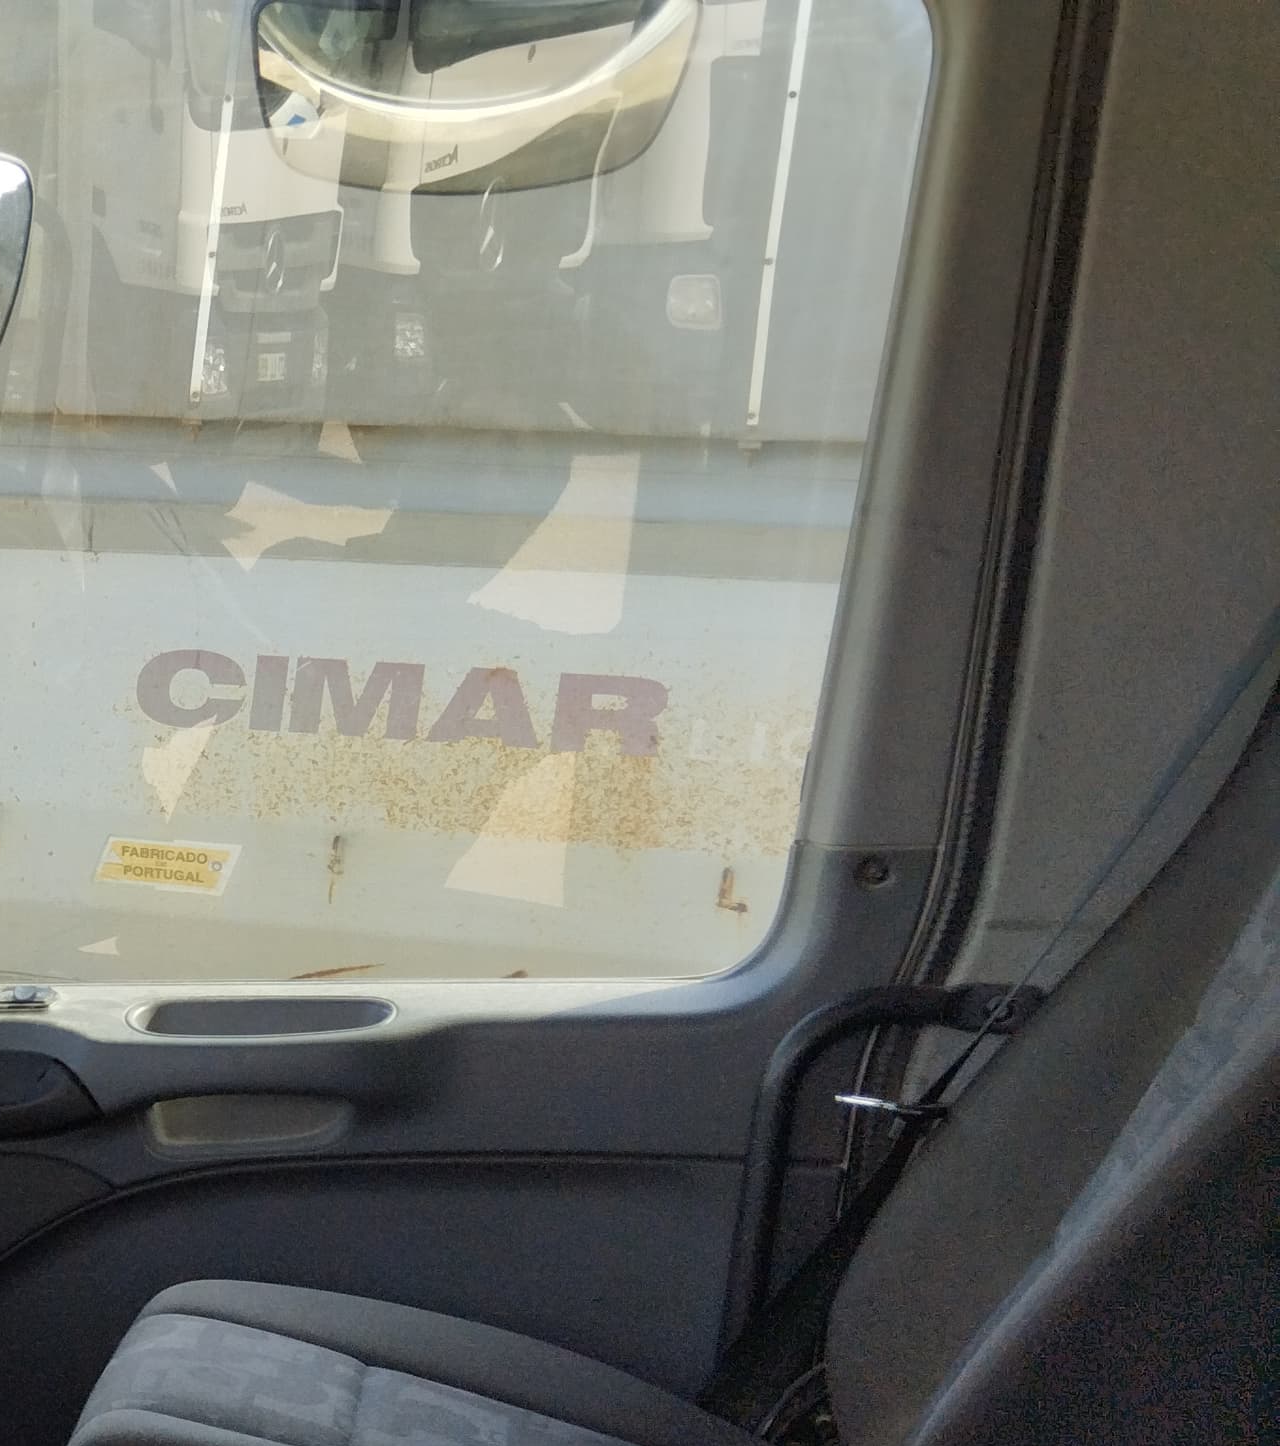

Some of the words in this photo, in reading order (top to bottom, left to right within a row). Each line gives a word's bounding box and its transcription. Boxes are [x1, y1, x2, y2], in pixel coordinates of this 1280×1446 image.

[136, 648, 671, 757] CIMAR
[120, 845, 210, 866] FABRICADO
[123, 864, 208, 885] PORTUGAL
